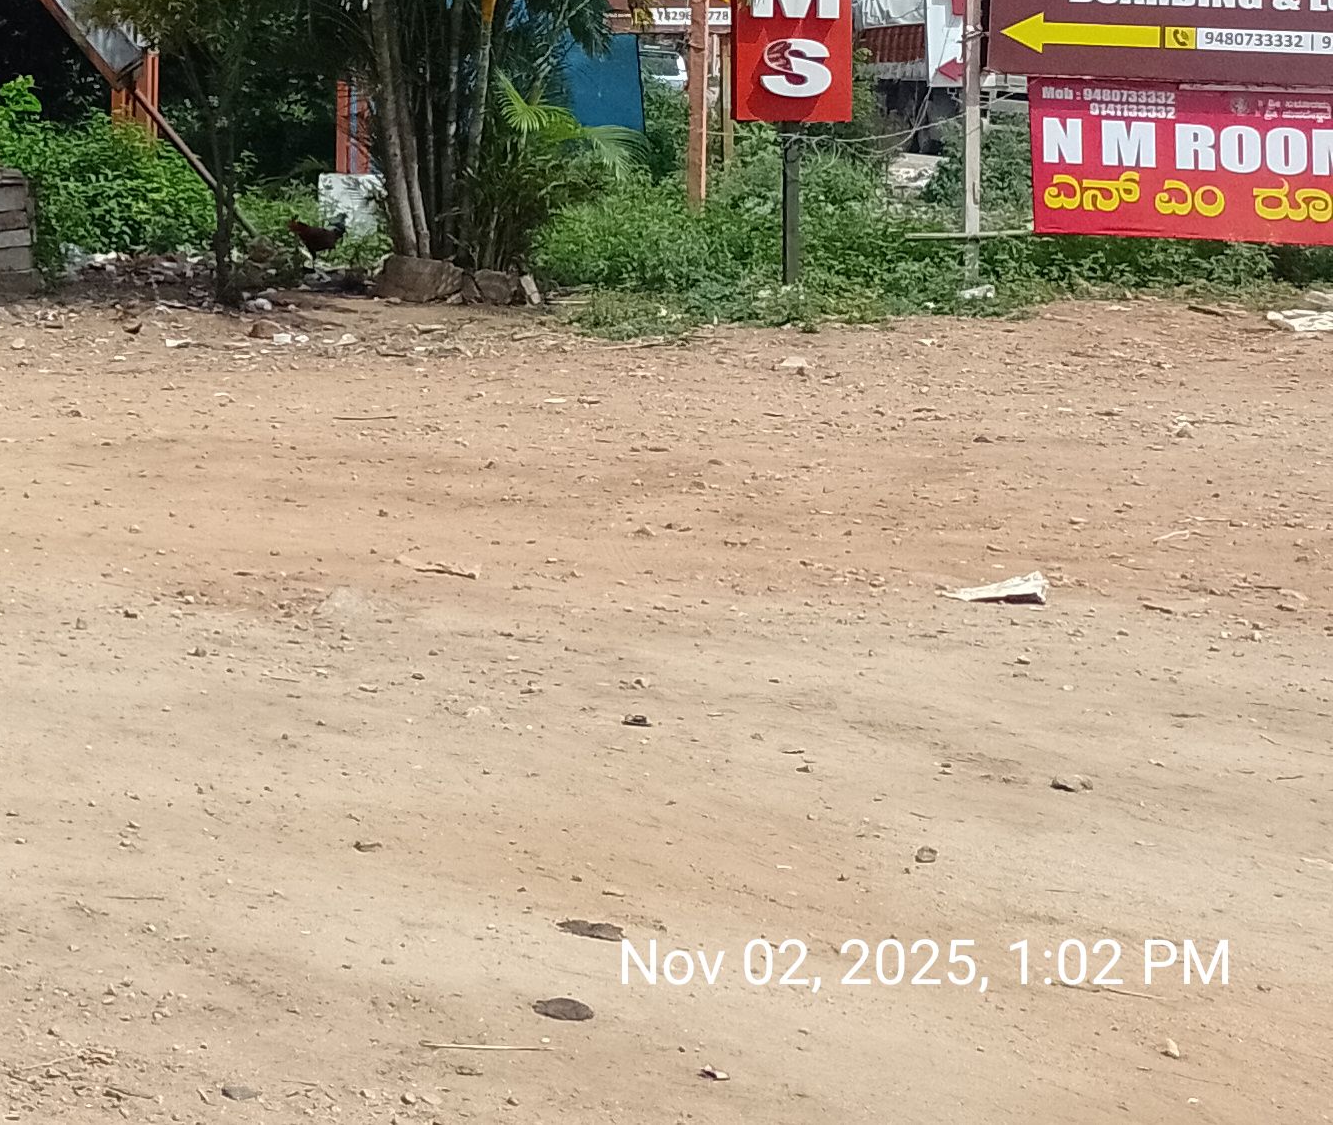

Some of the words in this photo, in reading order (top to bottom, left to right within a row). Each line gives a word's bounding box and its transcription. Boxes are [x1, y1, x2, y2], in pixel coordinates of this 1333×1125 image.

[1204, 31, 1304, 49] 9480733332
[1082, 88, 1176, 105] 9480733332
[1042, 116, 1083, 165] N
[1100, 119, 1157, 169] M
